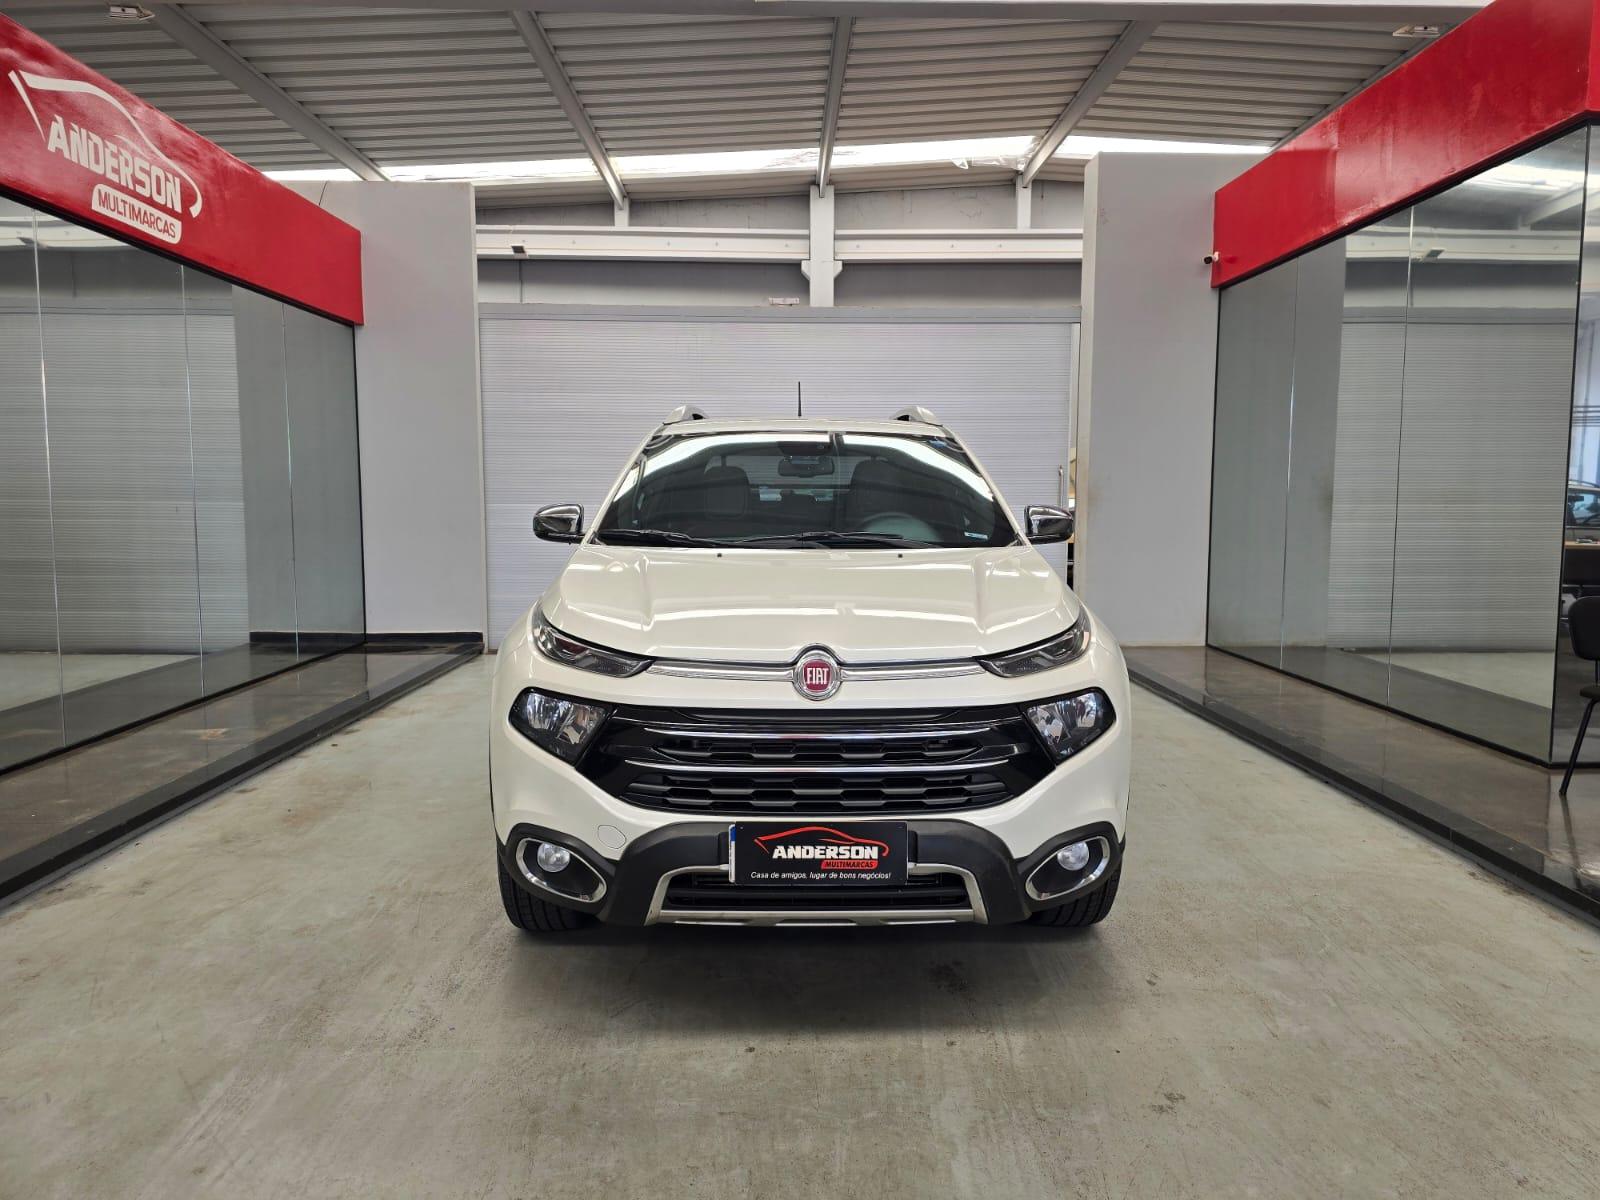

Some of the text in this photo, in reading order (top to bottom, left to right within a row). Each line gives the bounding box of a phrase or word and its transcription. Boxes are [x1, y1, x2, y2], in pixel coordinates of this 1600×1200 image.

[47, 114, 182, 213] ANDERSON
[98, 188, 176, 238] MULTIMARCAS
[806, 667, 829, 685] FIAT
[772, 845, 879, 859] ANDERSON
[825, 860, 875, 868] MULTIMARCAS
[750, 871, 892, 880] Casa de amigos, lugar de bons negócios!
